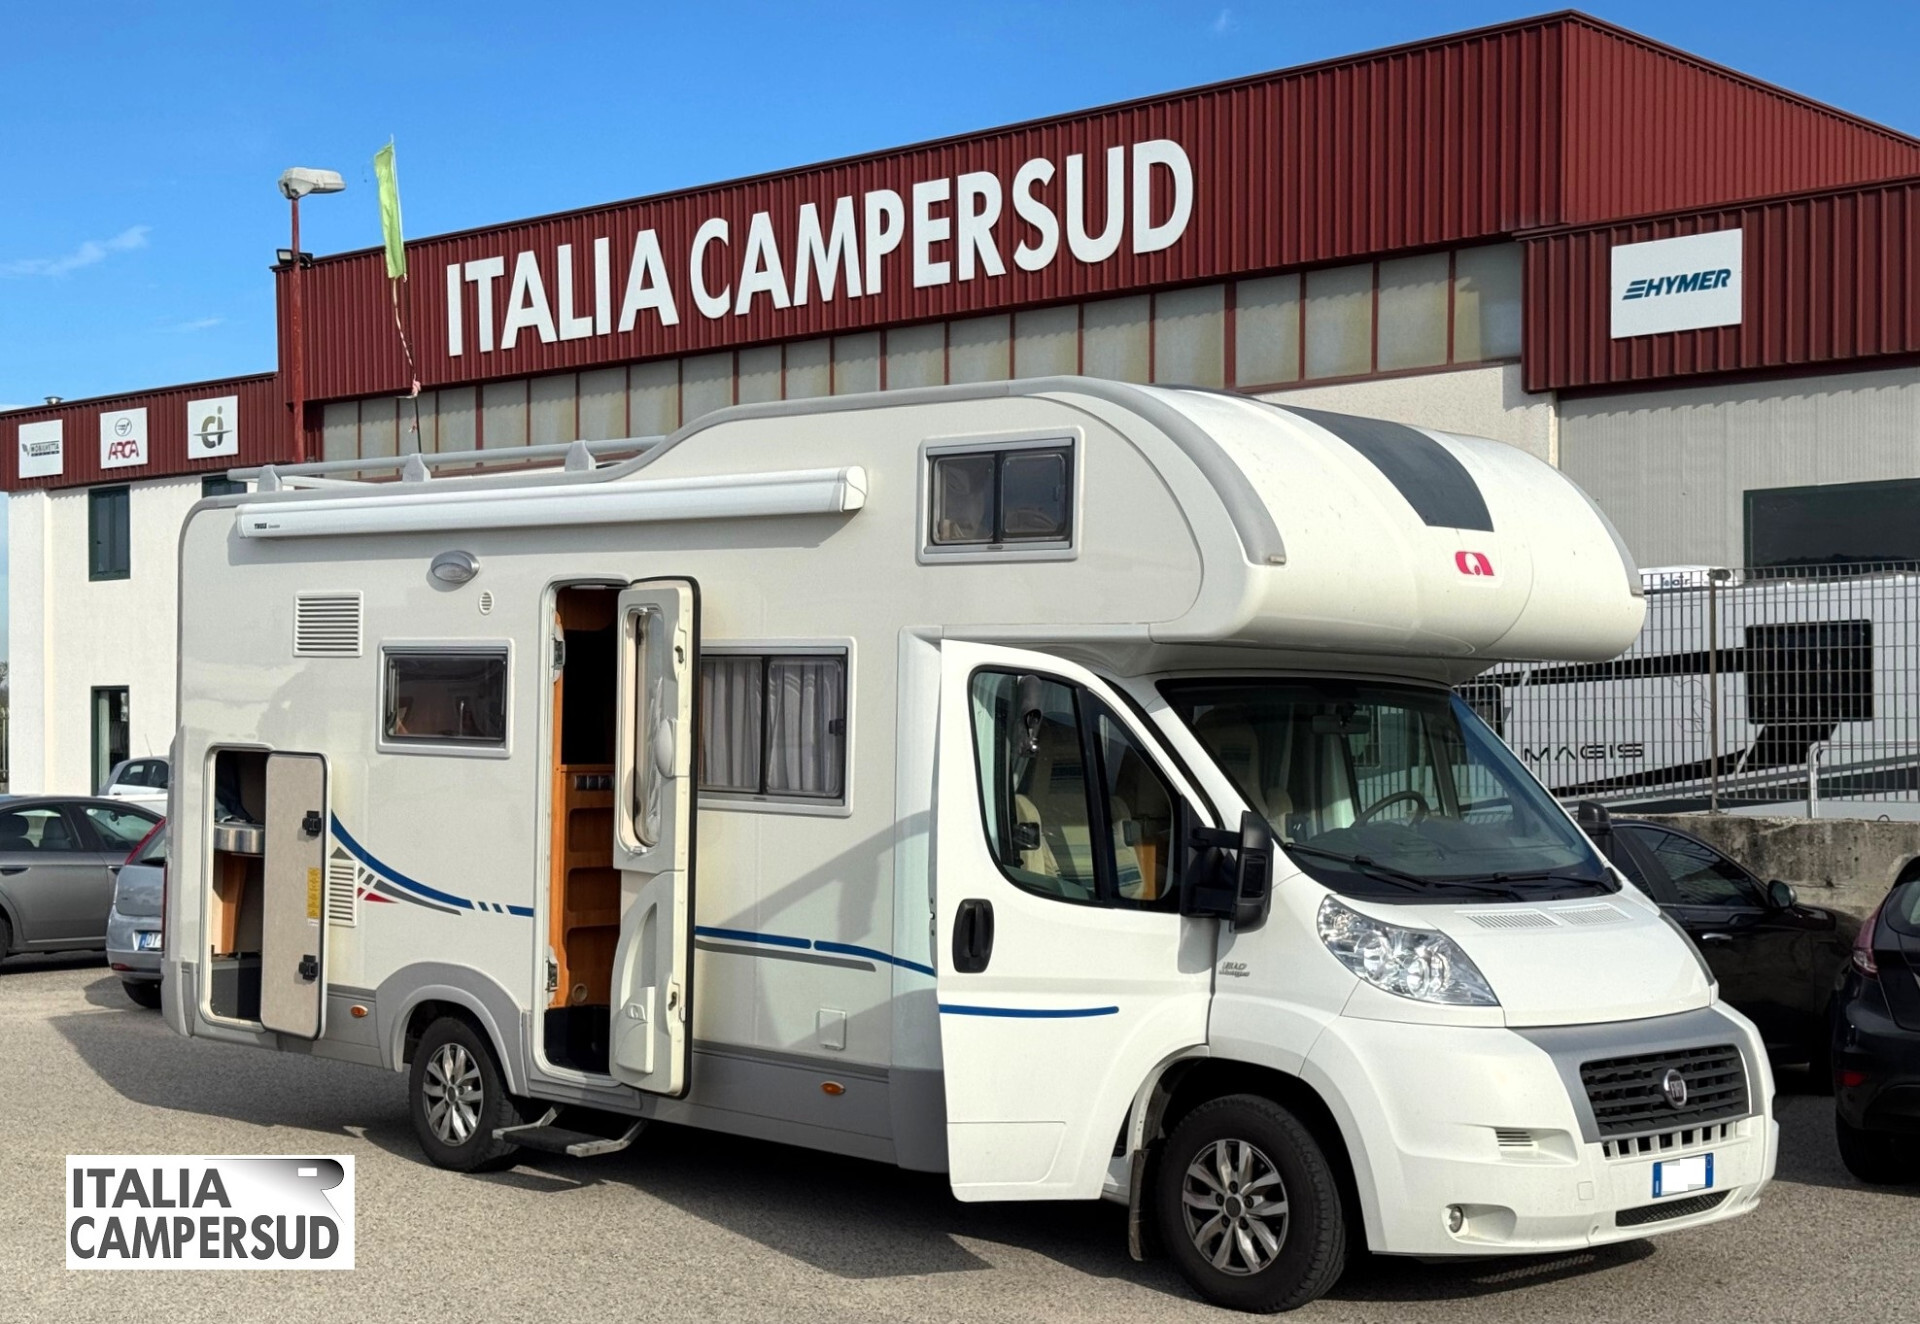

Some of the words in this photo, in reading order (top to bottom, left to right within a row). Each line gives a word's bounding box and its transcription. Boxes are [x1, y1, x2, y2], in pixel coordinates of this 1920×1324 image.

[446, 228, 680, 358] ITALIA
[690, 139, 1194, 320] CAMPERSUD
[1642, 268, 1732, 298] HYMER
[108, 439, 139, 461] ARCA
[1524, 743, 1644, 763] MAGIS
